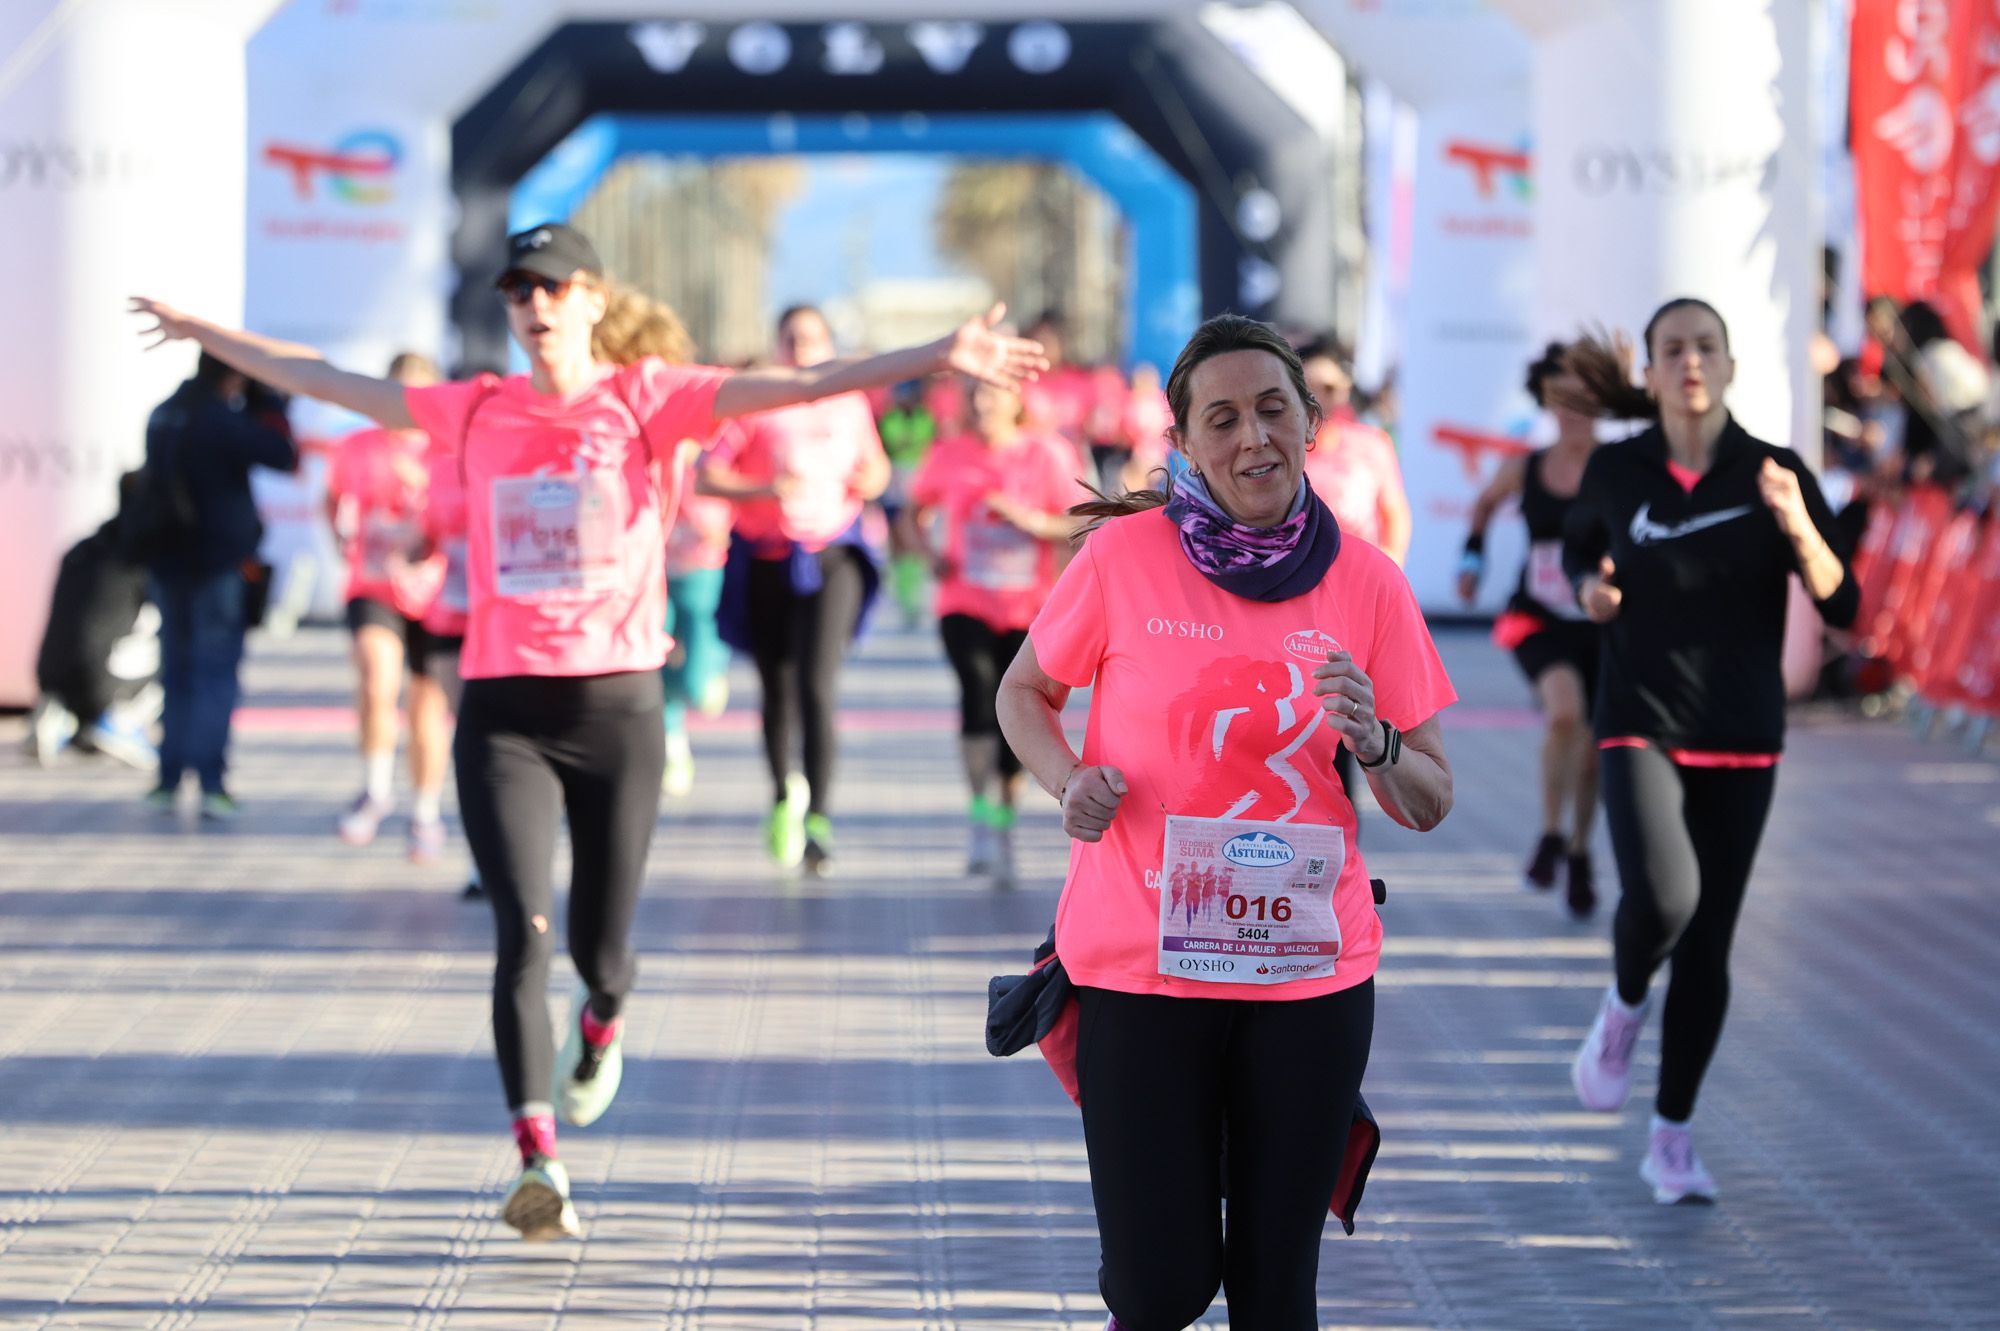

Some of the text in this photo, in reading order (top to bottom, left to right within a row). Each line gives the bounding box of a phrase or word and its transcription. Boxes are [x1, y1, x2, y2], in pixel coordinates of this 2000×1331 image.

[628, 18, 1071, 76] VOLVO
[1147, 617, 1224, 641] OYSHO
[1180, 847, 1215, 858] SUMA
[1227, 843, 1290, 860] ASTURIANA
[1225, 894, 1292, 922] 016
[1237, 928, 1270, 940] 5404
[1183, 940, 1319, 954] CARRERA DE LA MUJER VALENCIA
[1179, 958, 1235, 972] OYSHO
